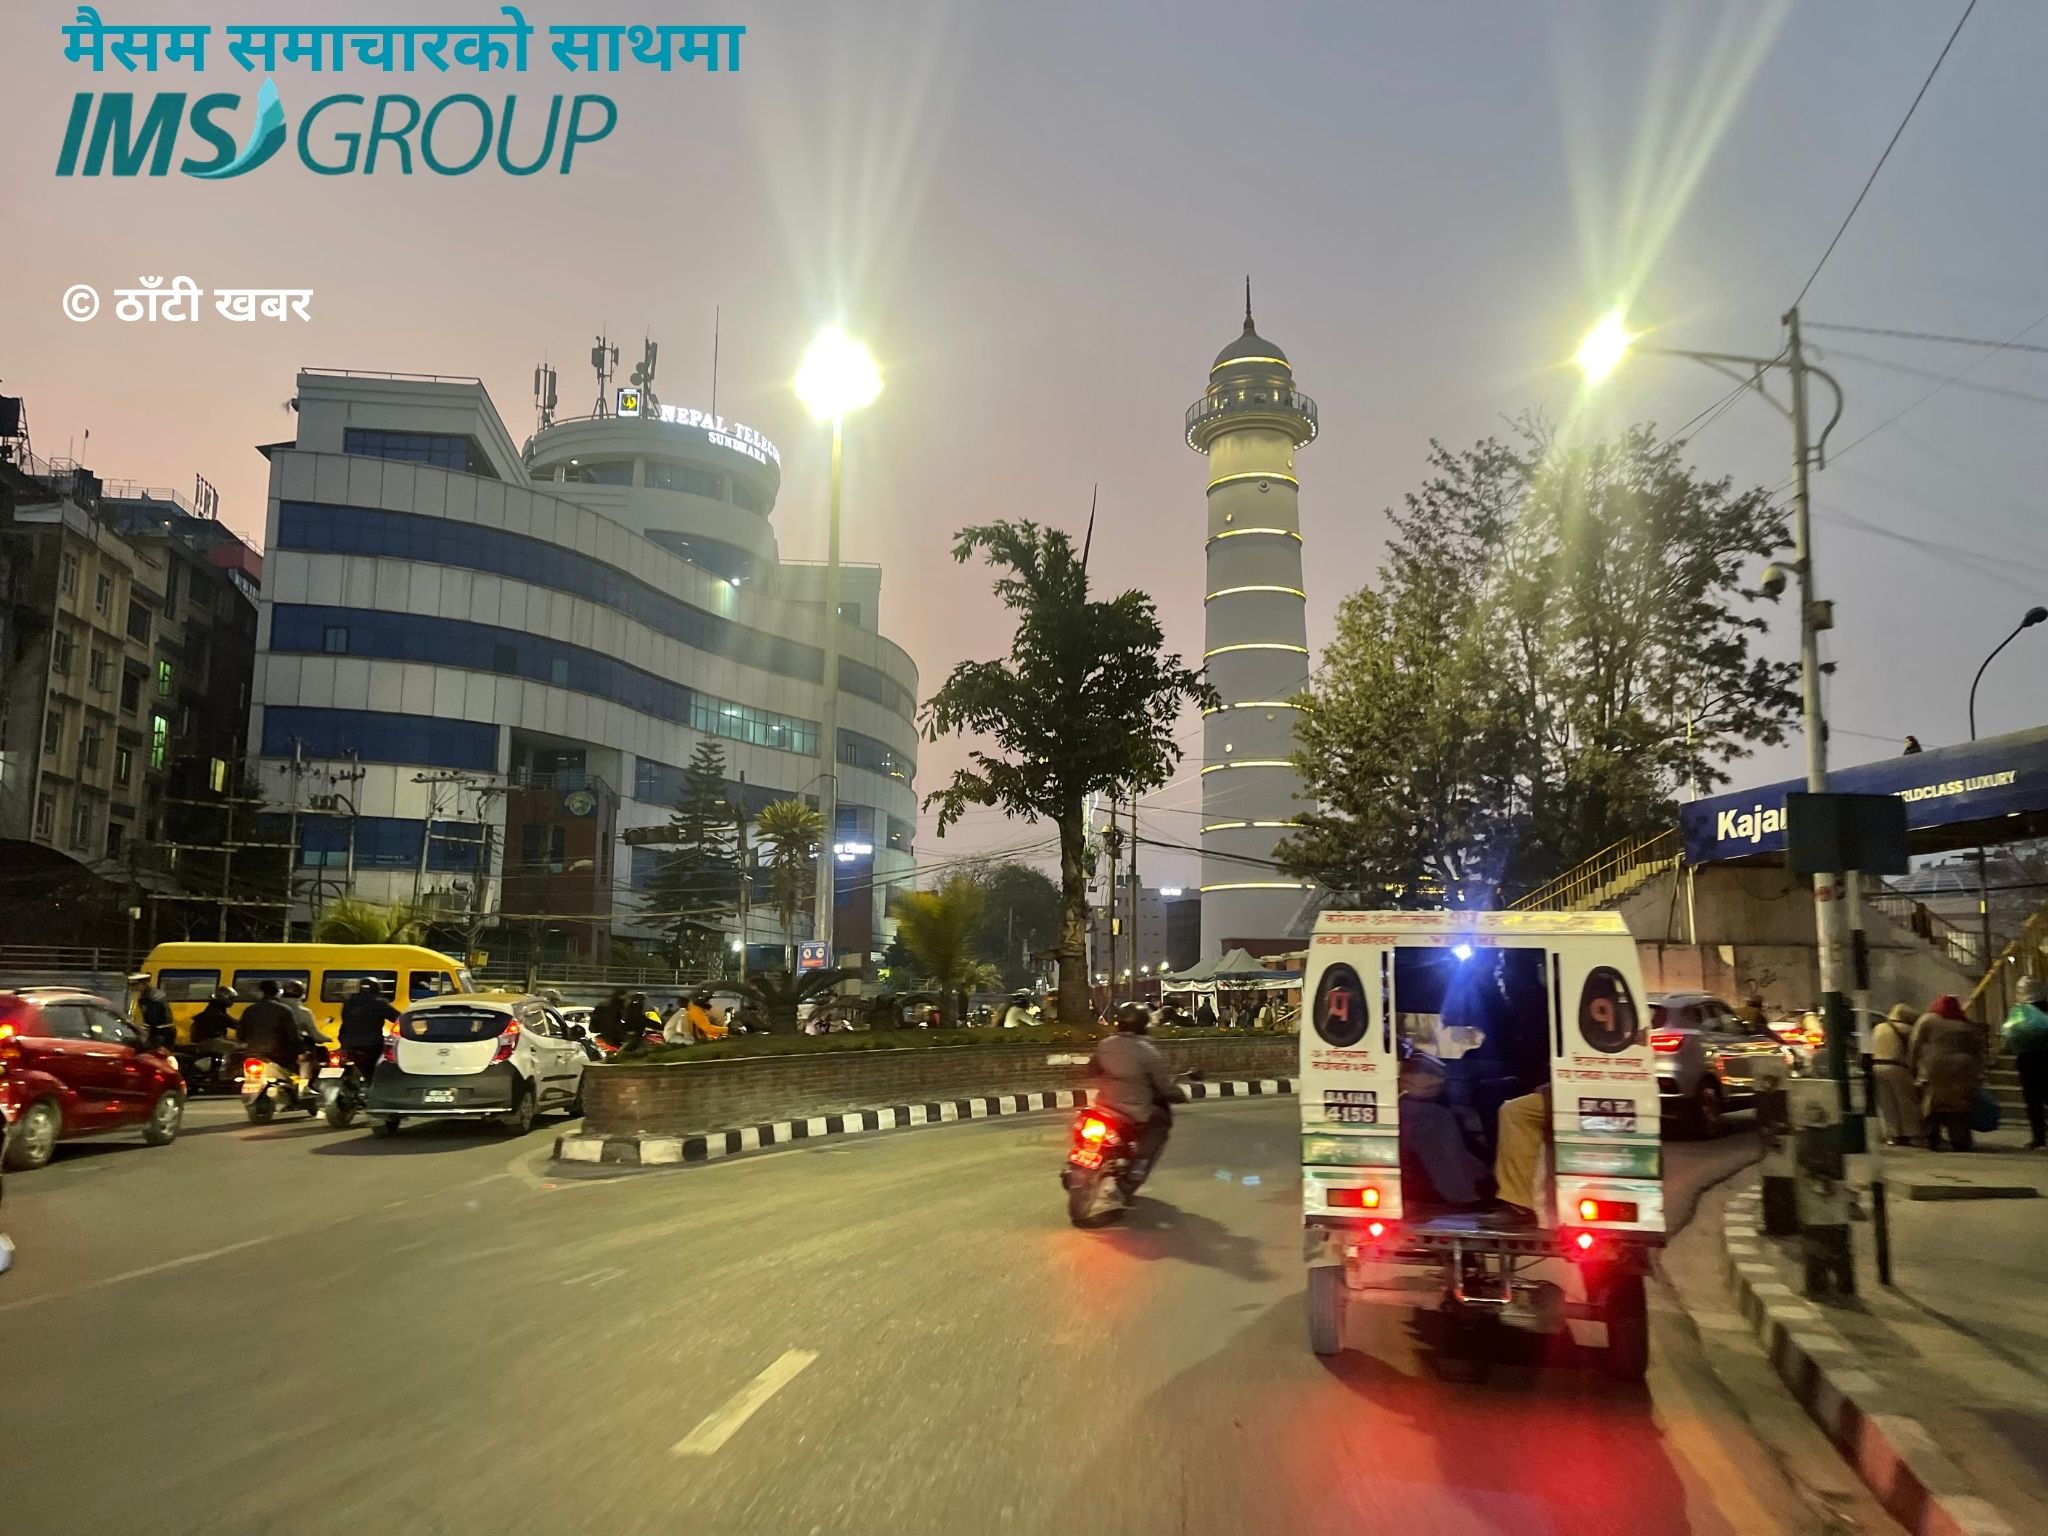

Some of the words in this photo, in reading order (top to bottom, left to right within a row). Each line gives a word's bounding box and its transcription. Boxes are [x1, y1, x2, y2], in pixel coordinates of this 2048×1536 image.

[660, 405, 728, 434] NEPAL
[734, 422, 781, 470] TELECO
[1889, 780, 1965, 803] RLDCLASS
[1966, 769, 2017, 792] LUXURY
[1327, 1106, 1375, 1123] 4158
